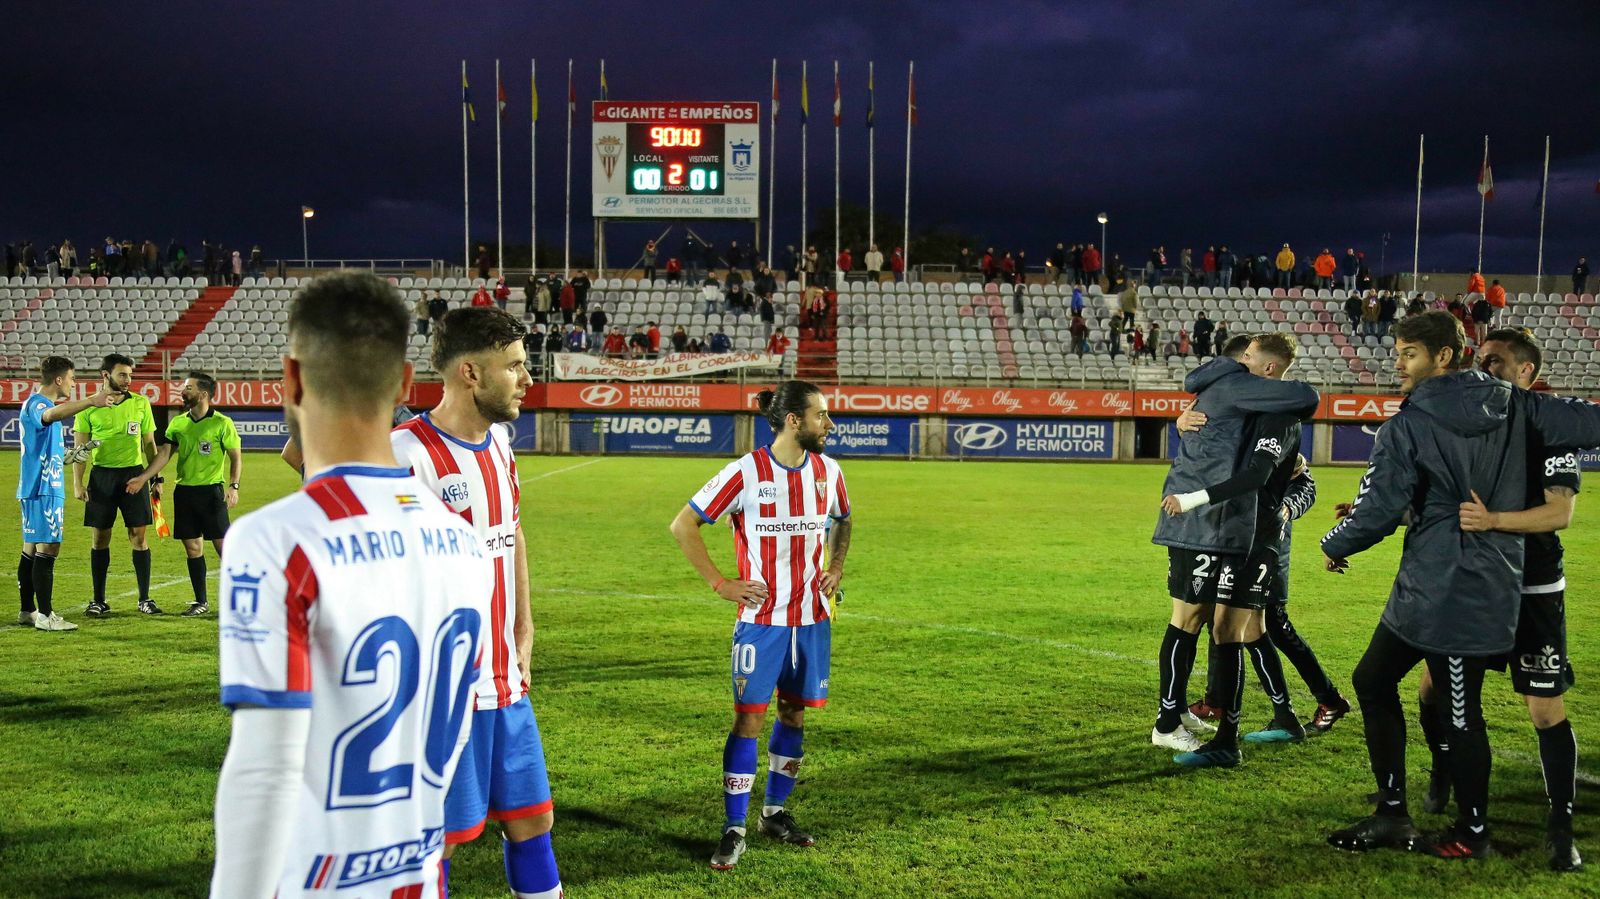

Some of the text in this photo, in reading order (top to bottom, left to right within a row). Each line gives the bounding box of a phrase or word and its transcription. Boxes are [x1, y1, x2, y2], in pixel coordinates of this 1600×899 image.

[607, 107, 665, 119] GIGANTE
[680, 105, 753, 119] EMPEÑOS
[633, 154, 720, 163] LOCAL VISITANTE
[633, 163, 718, 190] 00 2 01
[629, 197, 678, 205] PERMOTOR
[681, 197, 732, 205] ALGECIRAS
[575, 366, 647, 377] ALGECIRAS
[653, 366, 670, 376] EN
[677, 363, 692, 373] EL
[261, 383, 283, 405] ES
[630, 385, 700, 397] HYUNDAI
[630, 397, 700, 408] PERMOTOR
[943, 389, 973, 411] Okay
[992, 390, 1022, 413] Okay
[1048, 391, 1078, 413] Okay
[1101, 392, 1131, 414] Okay
[1142, 399, 1191, 411] HOTE
[1333, 399, 1402, 417] CAS
[593, 417, 711, 434] EUROPEA
[829, 421, 889, 437] opulares
[1017, 424, 1105, 438] HYUNDAI
[675, 435, 711, 443] GROUP
[826, 436, 888, 447] de Algeciras
[1017, 439, 1105, 452] PERMOTOR
[755, 520, 824, 532] master.hous
[323, 530, 405, 566] MARIO
[1217, 573, 1234, 586] RC
[732, 643, 756, 675] 10
[1520, 654, 1561, 670] CRC
[325, 607, 482, 811] 20
